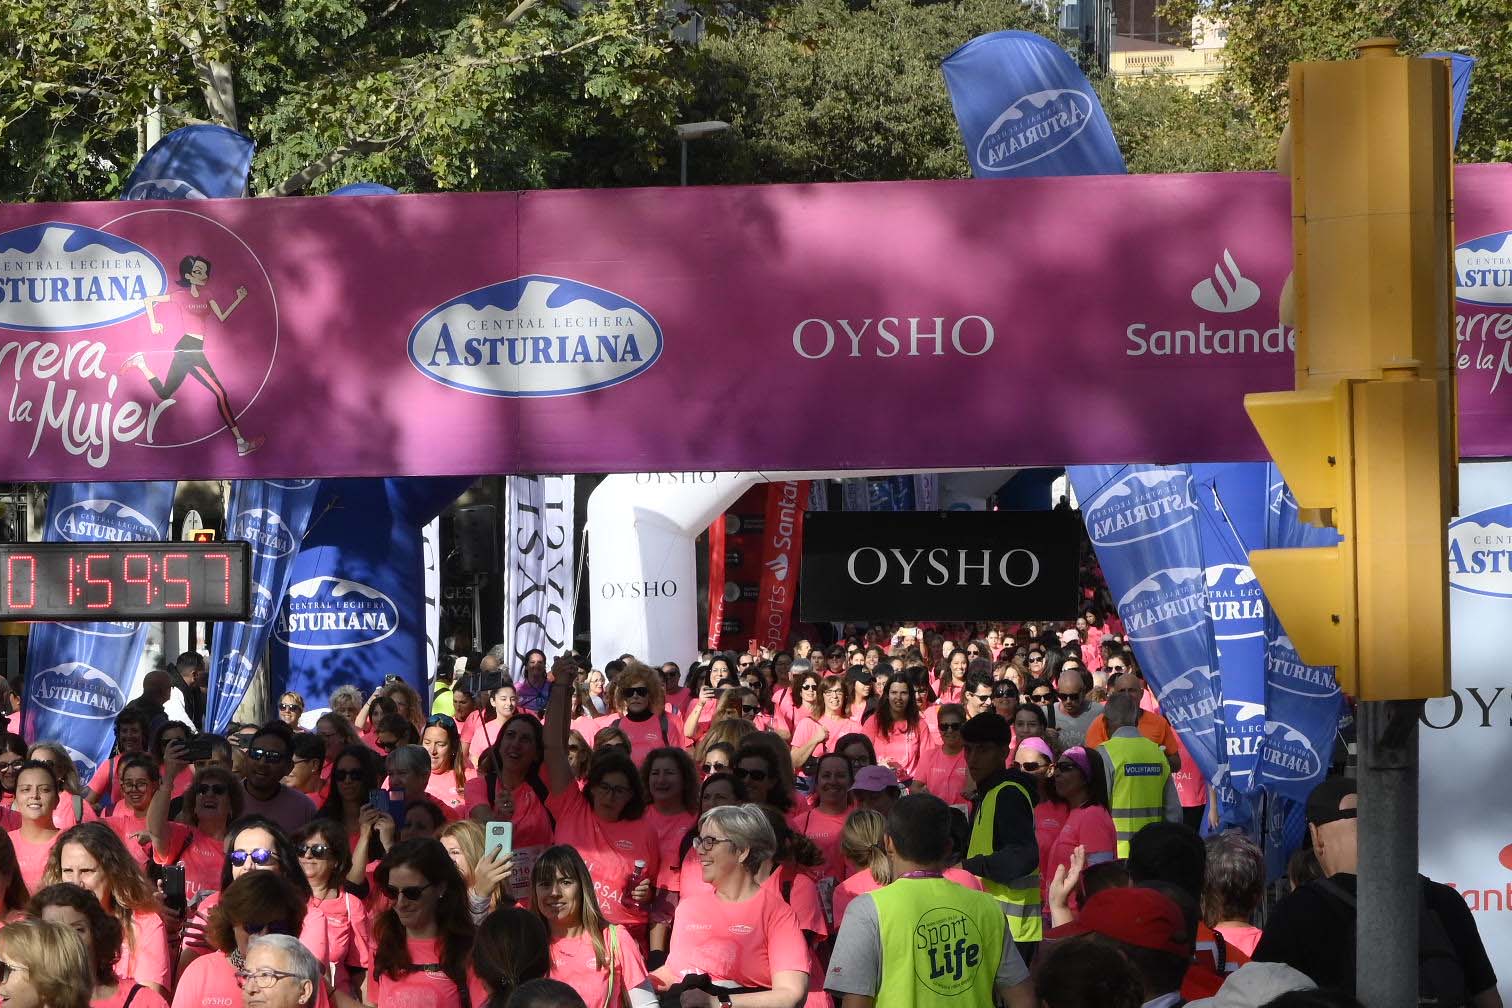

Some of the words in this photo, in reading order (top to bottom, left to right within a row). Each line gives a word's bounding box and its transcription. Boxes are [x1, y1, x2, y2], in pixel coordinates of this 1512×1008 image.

[69, 258, 142, 270] LECHERA
[466, 318, 545, 331] CENTRAL
[552, 315, 635, 328] LECHERA
[791, 314, 996, 360] OYSHO
[426, 321, 644, 368] ASTURIANA
[1476, 342, 1494, 369] la
[7, 383, 33, 423] la
[27, 374, 177, 469] Mujer
[846, 546, 1040, 588] OYSHO
[601, 579, 678, 600] OYSHO
[276, 602, 391, 632] ASTURIANA
[289, 600, 334, 611] CENTRAL
[336, 600, 386, 610] LECHERA
[35, 679, 119, 713] ASTURIANA
[185, 881, 201, 894] TU
[917, 916, 969, 949] Sport
[928, 938, 980, 981] Life
